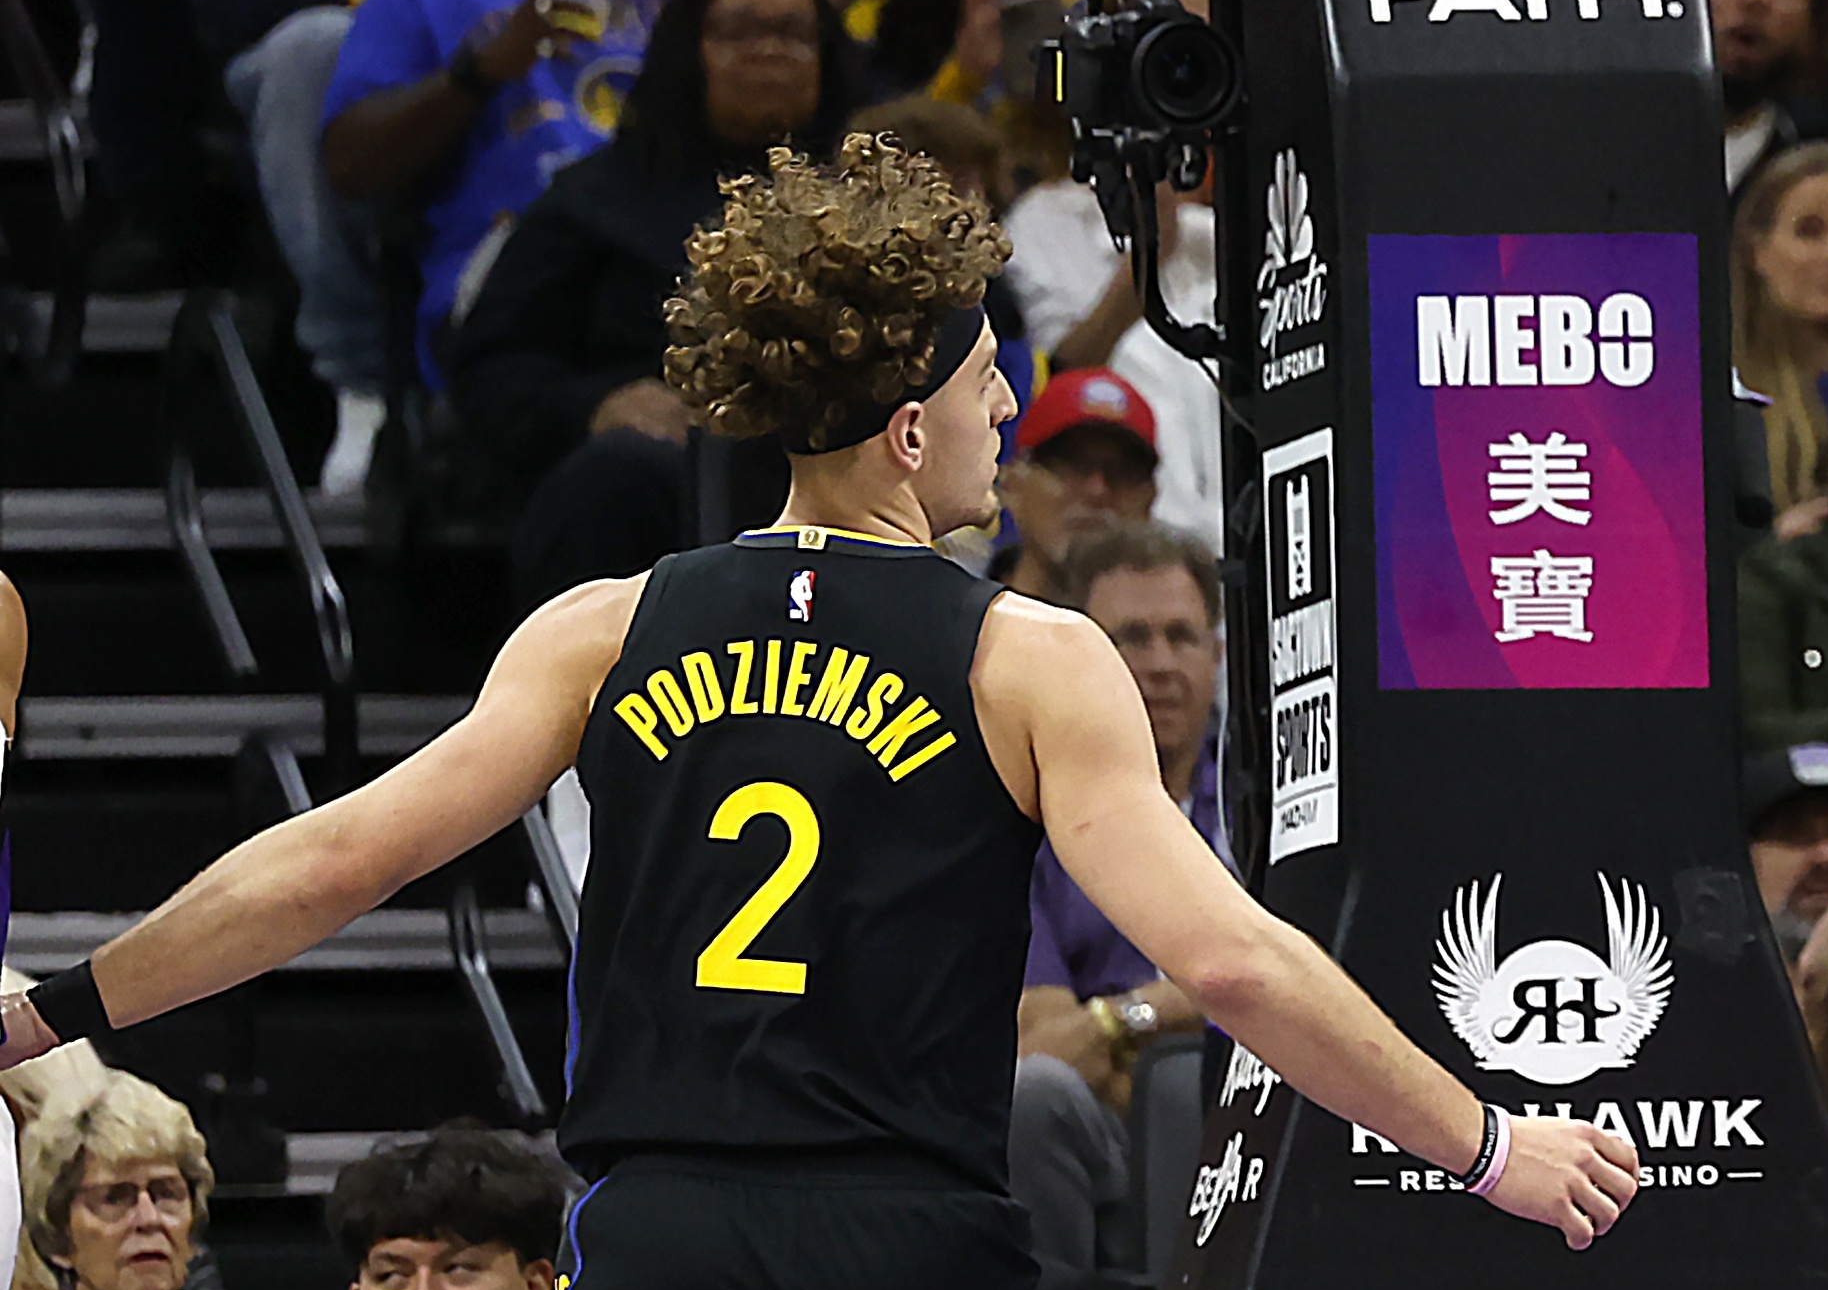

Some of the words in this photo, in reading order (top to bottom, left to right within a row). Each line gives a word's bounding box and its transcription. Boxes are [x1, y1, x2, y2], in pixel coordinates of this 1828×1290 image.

[1262, 342, 1326, 392] CALIFORNIA
[1416, 292, 1654, 387] MEBO
[613, 639, 958, 783] PODZIEMSKI
[1276, 692, 1332, 791] SPORTS
[696, 781, 821, 996] 2
[1400, 1170, 1466, 1191] RES
[1639, 1165, 1720, 1187] SINO
